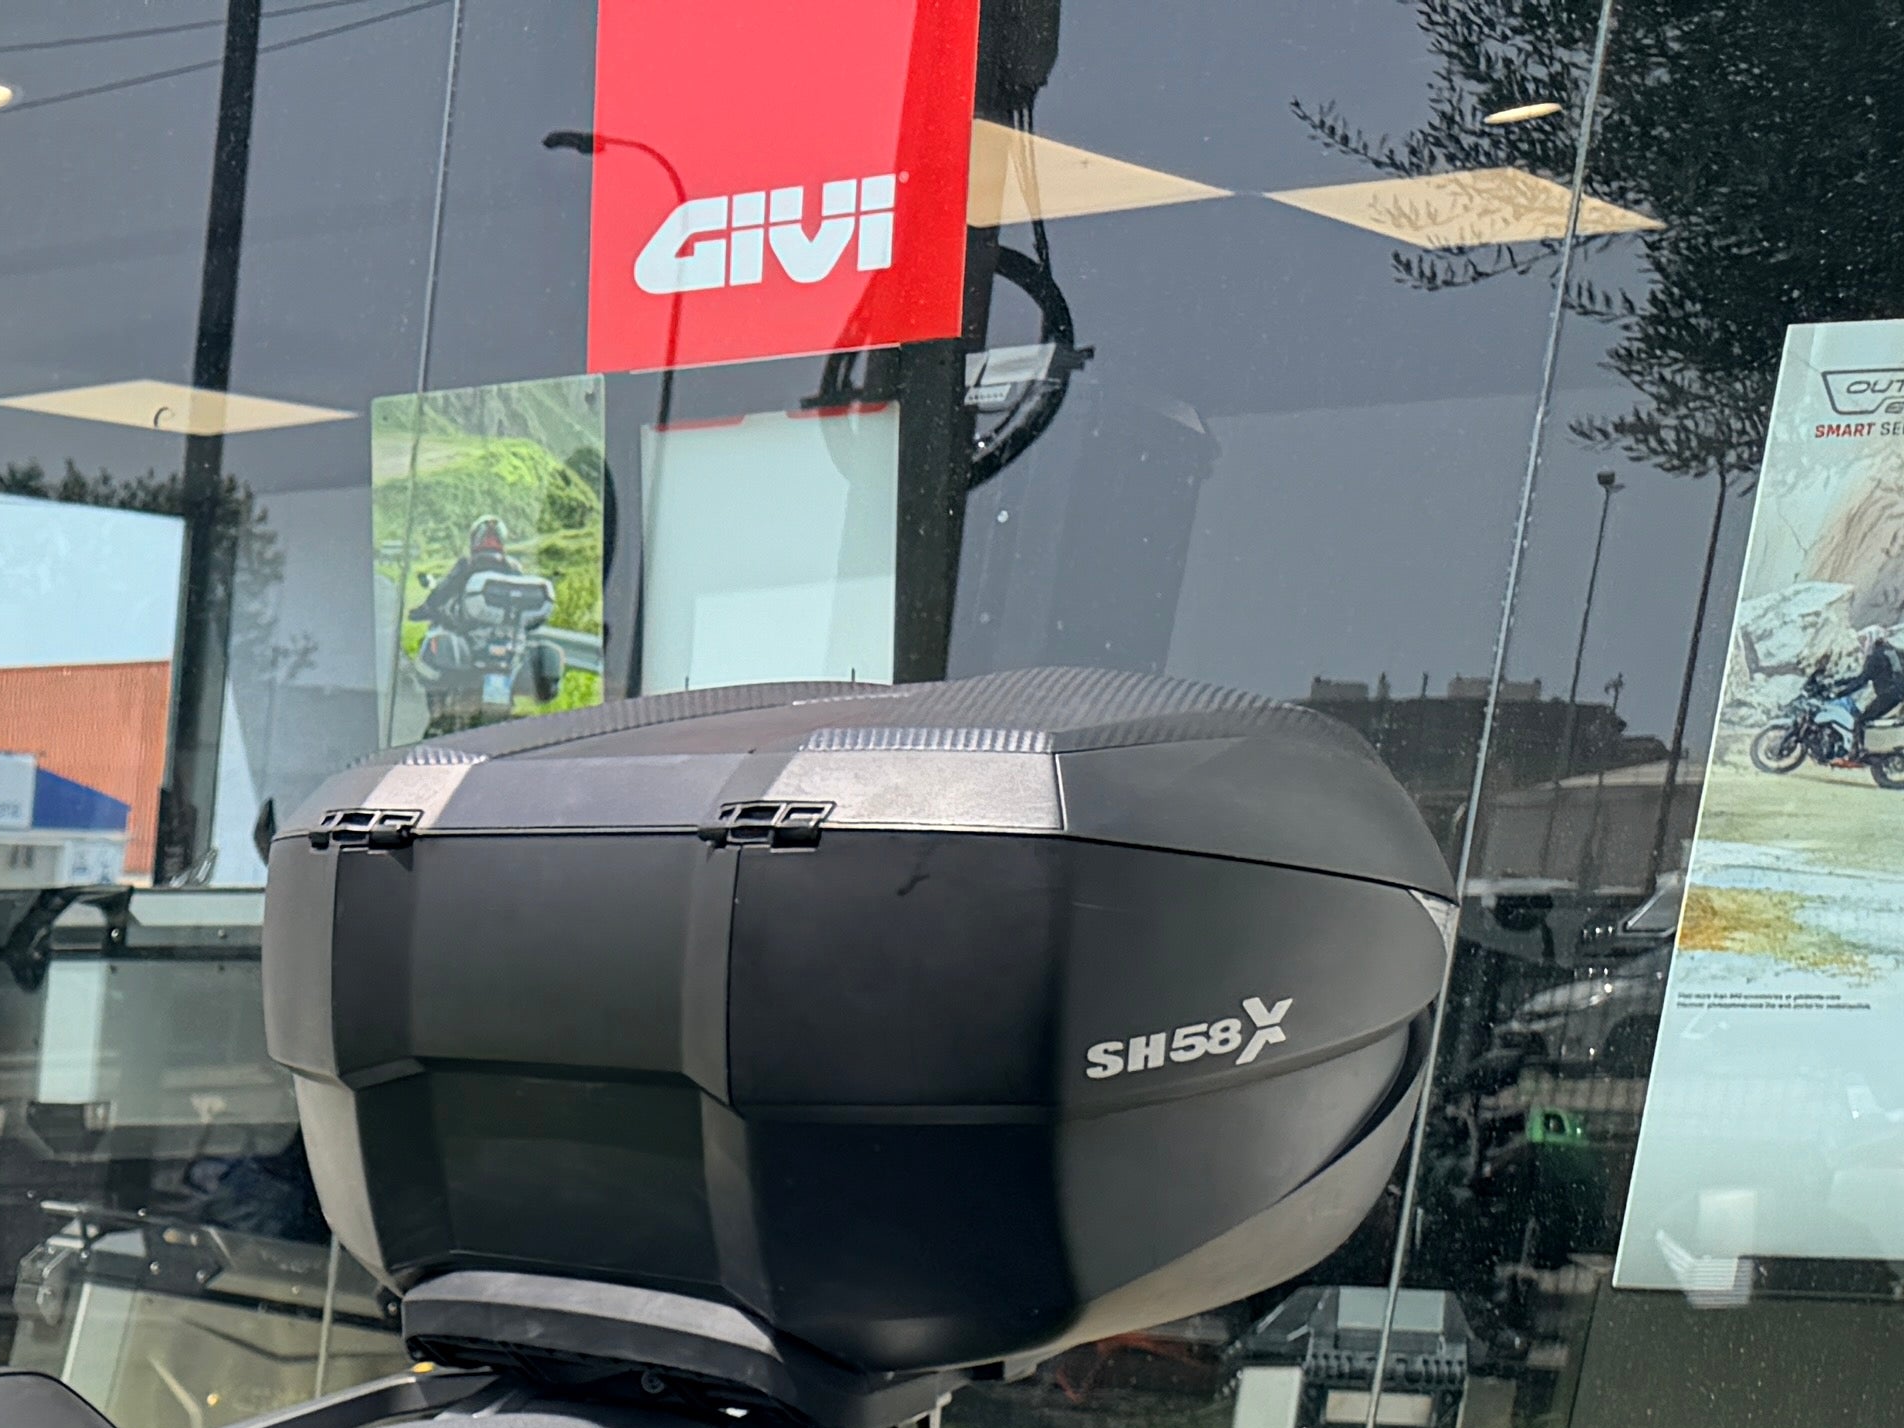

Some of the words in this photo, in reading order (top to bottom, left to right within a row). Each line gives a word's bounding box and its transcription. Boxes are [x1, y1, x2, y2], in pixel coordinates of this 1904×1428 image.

[634, 174, 897, 294] GIVI
[1815, 422, 1876, 439] SMART
[1879, 422, 1904, 436] SE
[1086, 997, 1293, 1079] SH58X
